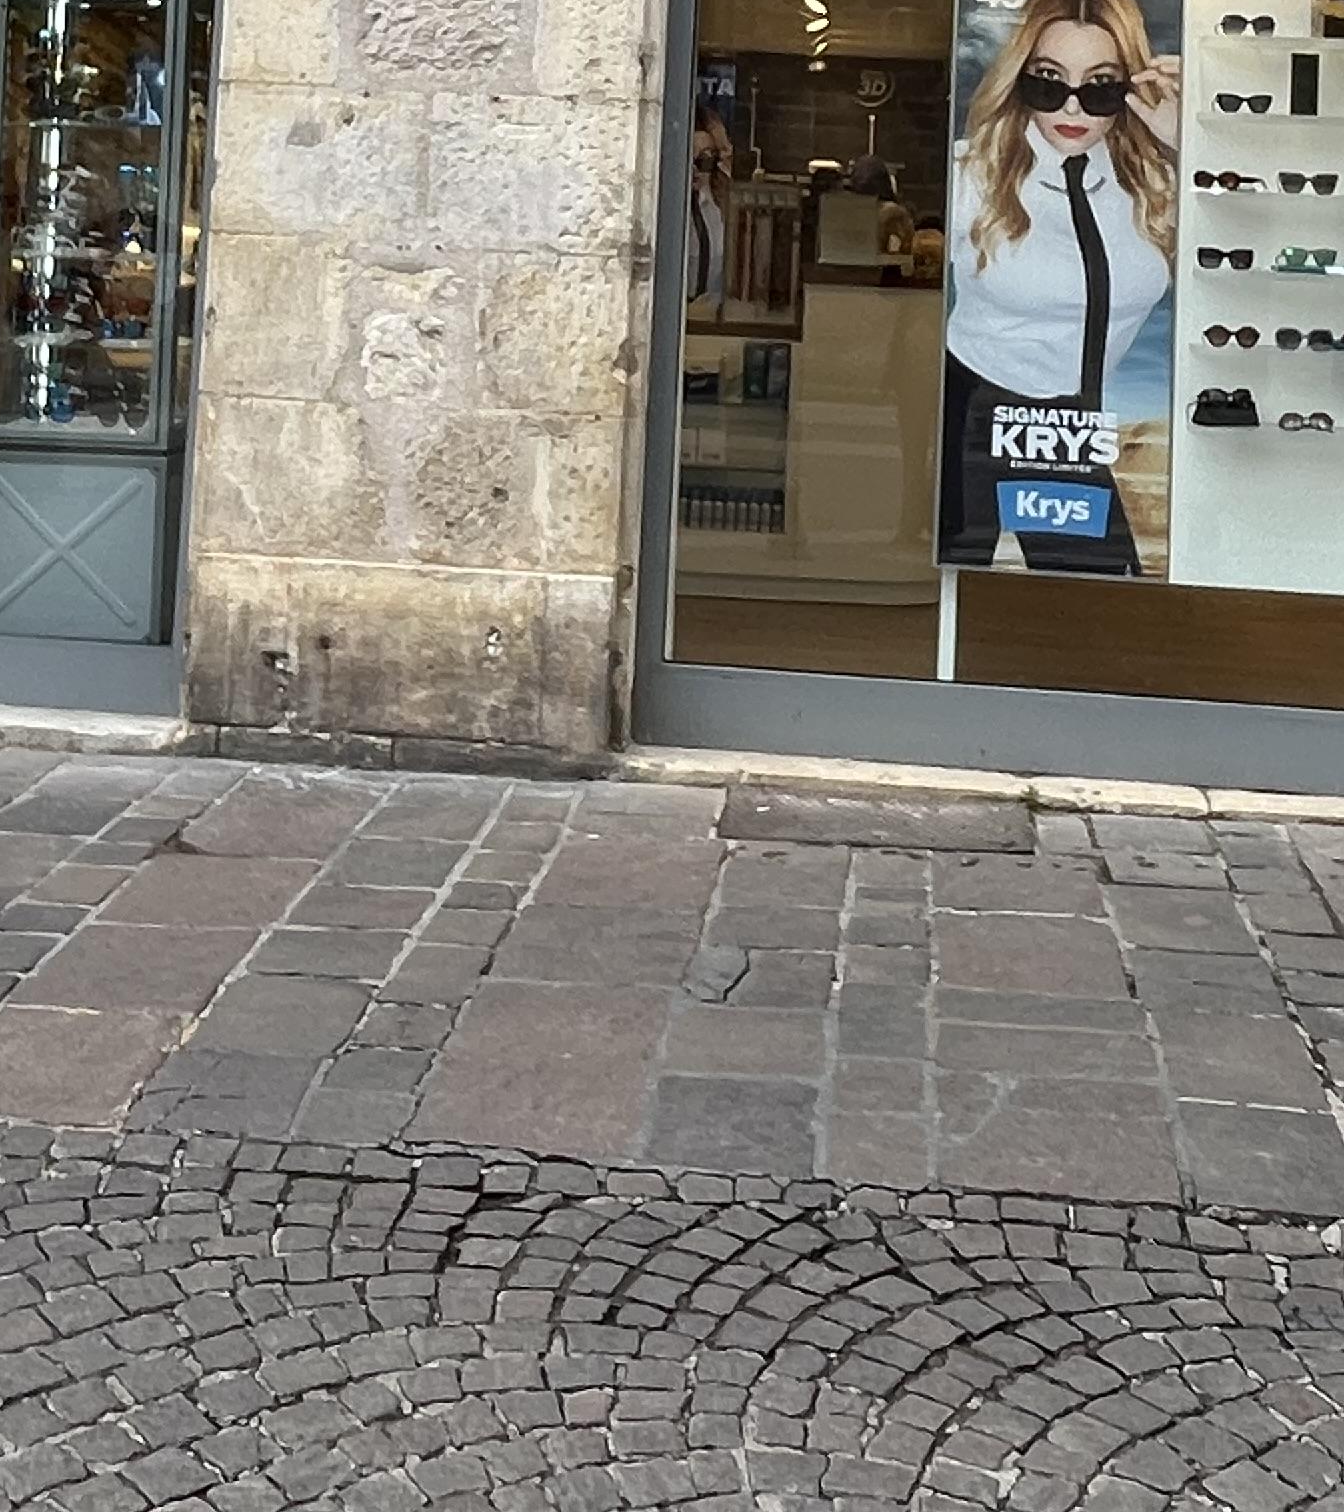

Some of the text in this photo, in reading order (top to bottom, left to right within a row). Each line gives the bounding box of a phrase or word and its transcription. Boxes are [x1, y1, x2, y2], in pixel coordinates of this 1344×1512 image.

[993, 404, 1119, 428] SIGNATURE
[991, 424, 1120, 465] KRYS
[1016, 490, 1090, 526] Krys
